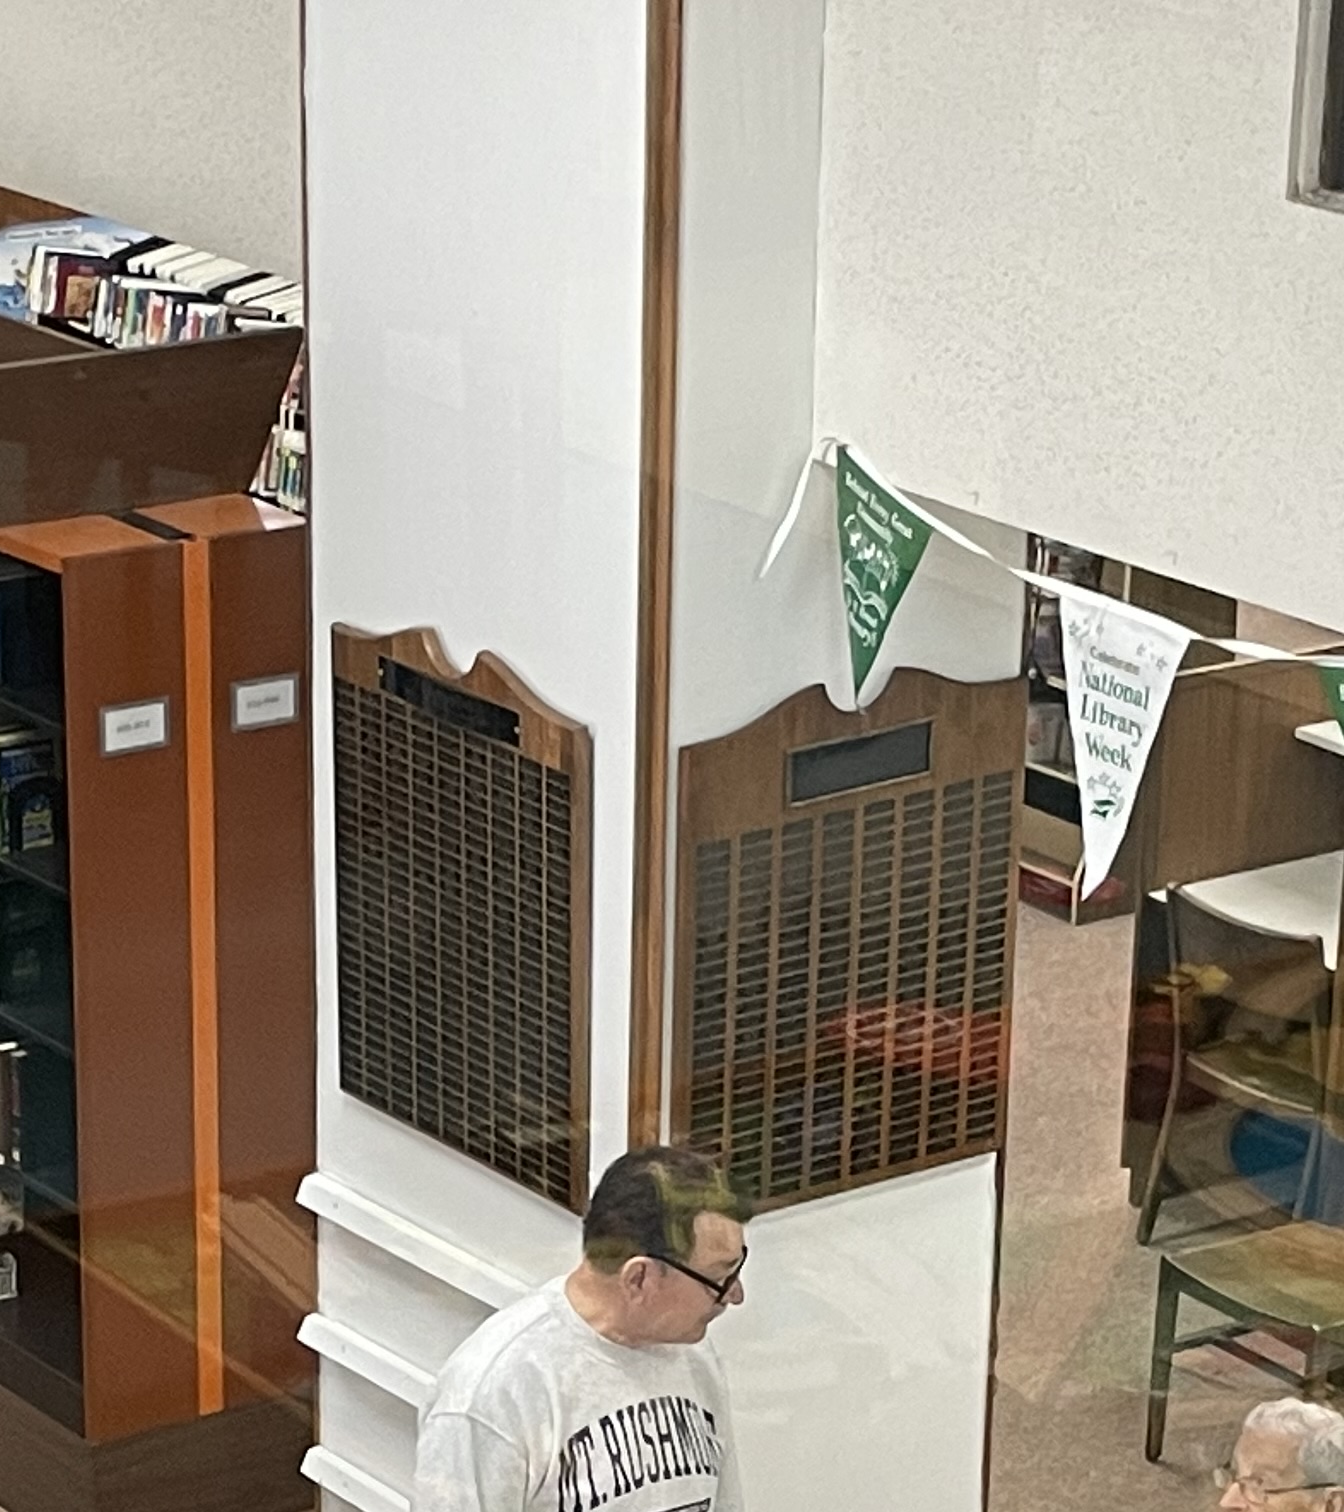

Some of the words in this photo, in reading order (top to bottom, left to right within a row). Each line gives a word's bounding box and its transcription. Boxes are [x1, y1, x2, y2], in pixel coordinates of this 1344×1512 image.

[1079, 660, 1150, 711] National
[1080, 693, 1143, 747] Library
[1085, 732, 1132, 772] Week
